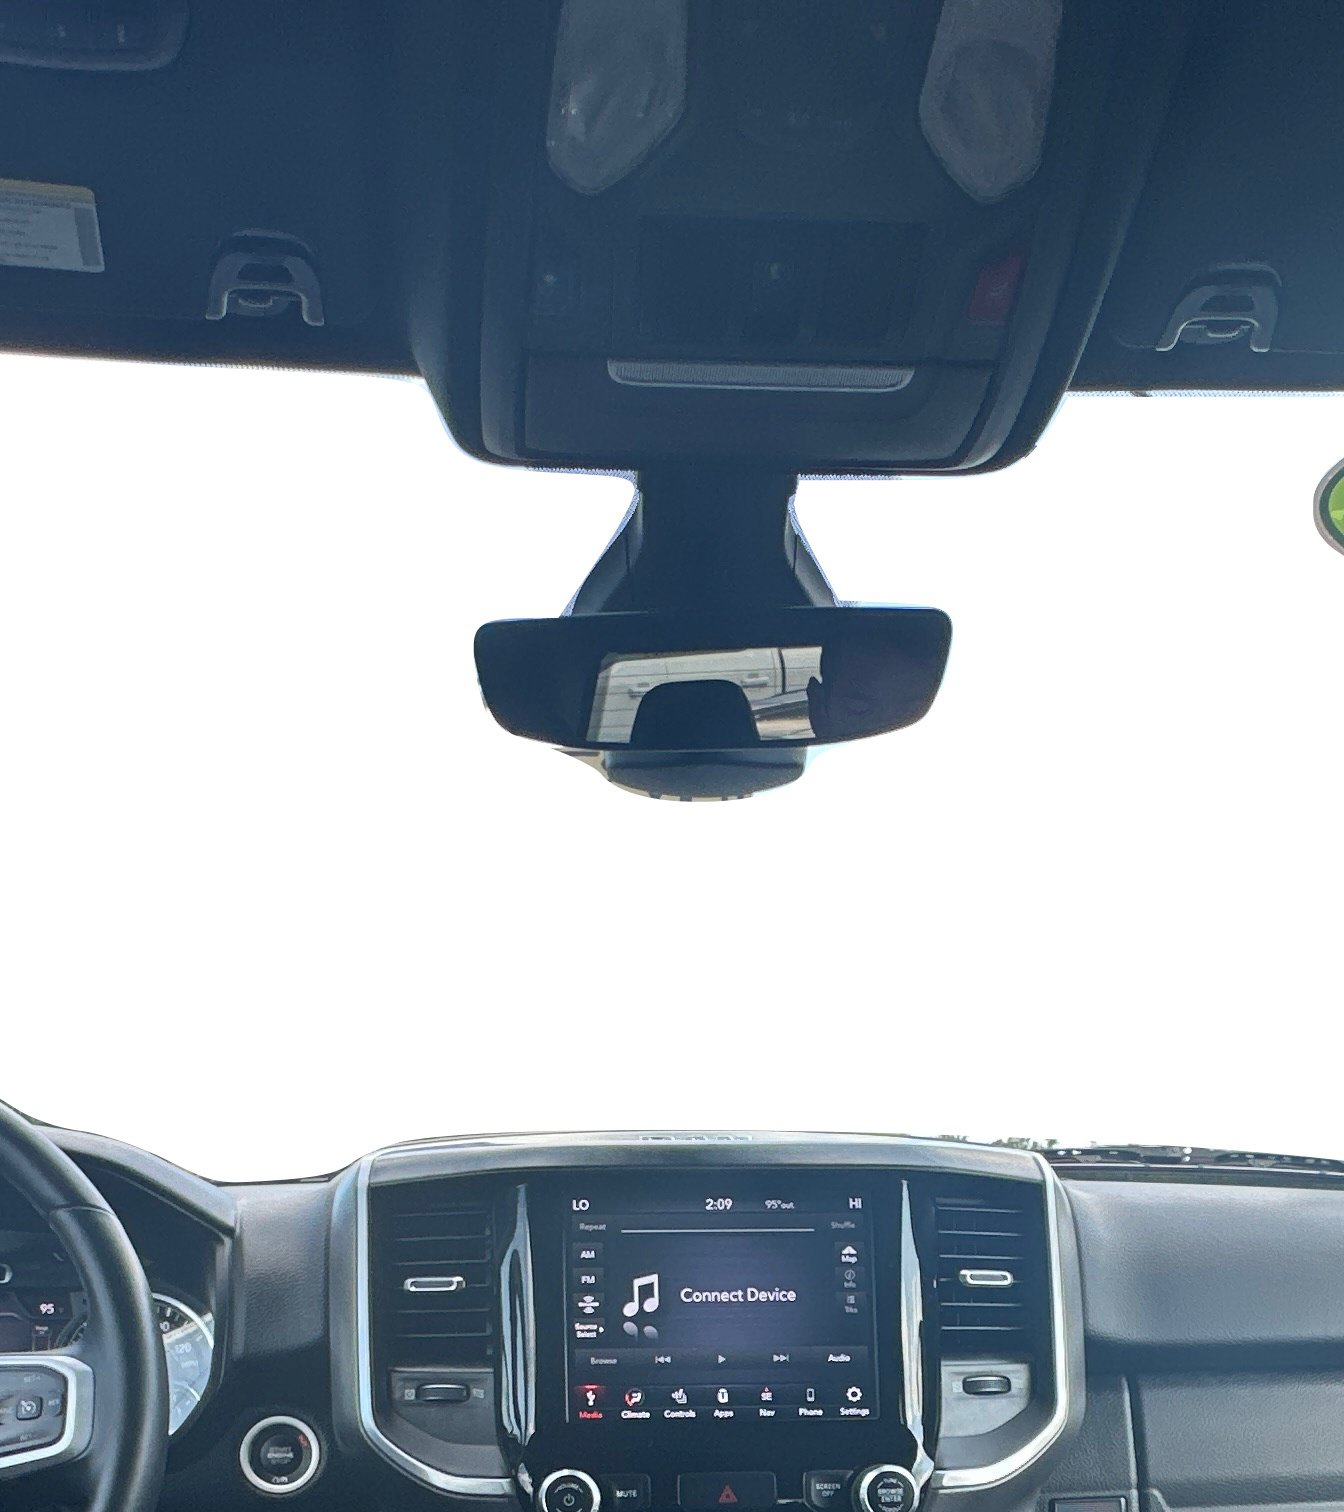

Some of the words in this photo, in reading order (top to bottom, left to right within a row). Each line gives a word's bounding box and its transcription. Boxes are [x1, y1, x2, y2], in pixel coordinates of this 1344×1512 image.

[572, 1199, 590, 1211] LO
[706, 1198, 733, 1211] 2:09
[848, 1197, 862, 1209] HI
[580, 1250, 596, 1259] AM
[581, 1275, 596, 1284] FM
[680, 1287, 745, 1303] Connect
[747, 1286, 797, 1302] Device
[39, 1303, 55, 1315] 95
[827, 1353, 852, 1363] Audio
[621, 1409, 651, 1419] Climate
[663, 1409, 697, 1418] Controls
[713, 1409, 734, 1419] Apps
[759, 1408, 776, 1417] Nav
[798, 1407, 824, 1417] Phone
[839, 1407, 870, 1418] Settings
[616, 1489, 637, 1498] MUTE
